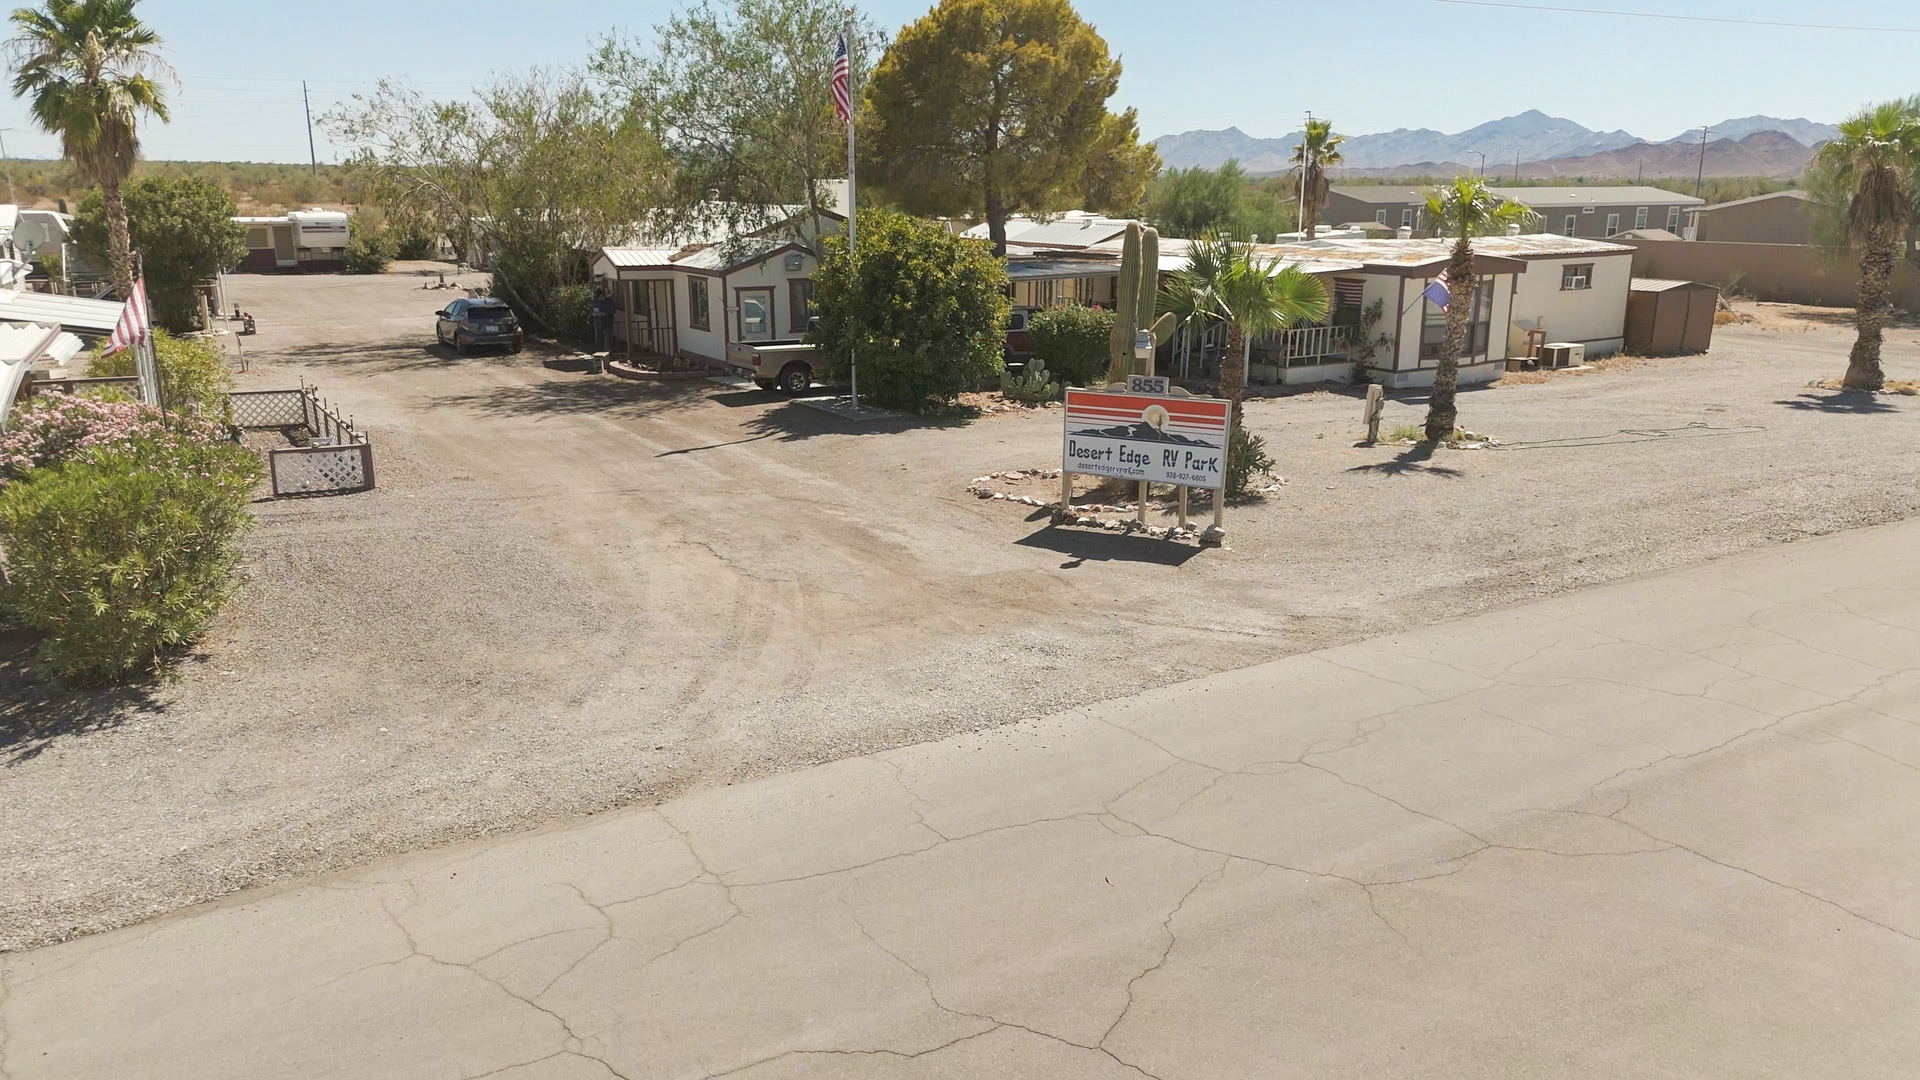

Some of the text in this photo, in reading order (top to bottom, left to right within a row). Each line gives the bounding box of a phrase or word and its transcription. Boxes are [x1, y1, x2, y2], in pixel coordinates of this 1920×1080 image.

[1132, 378, 1164, 393] 855
[1069, 439, 1113, 461] Desert
[1119, 445, 1151, 467] Edge
[1162, 449, 1179, 468] RV
